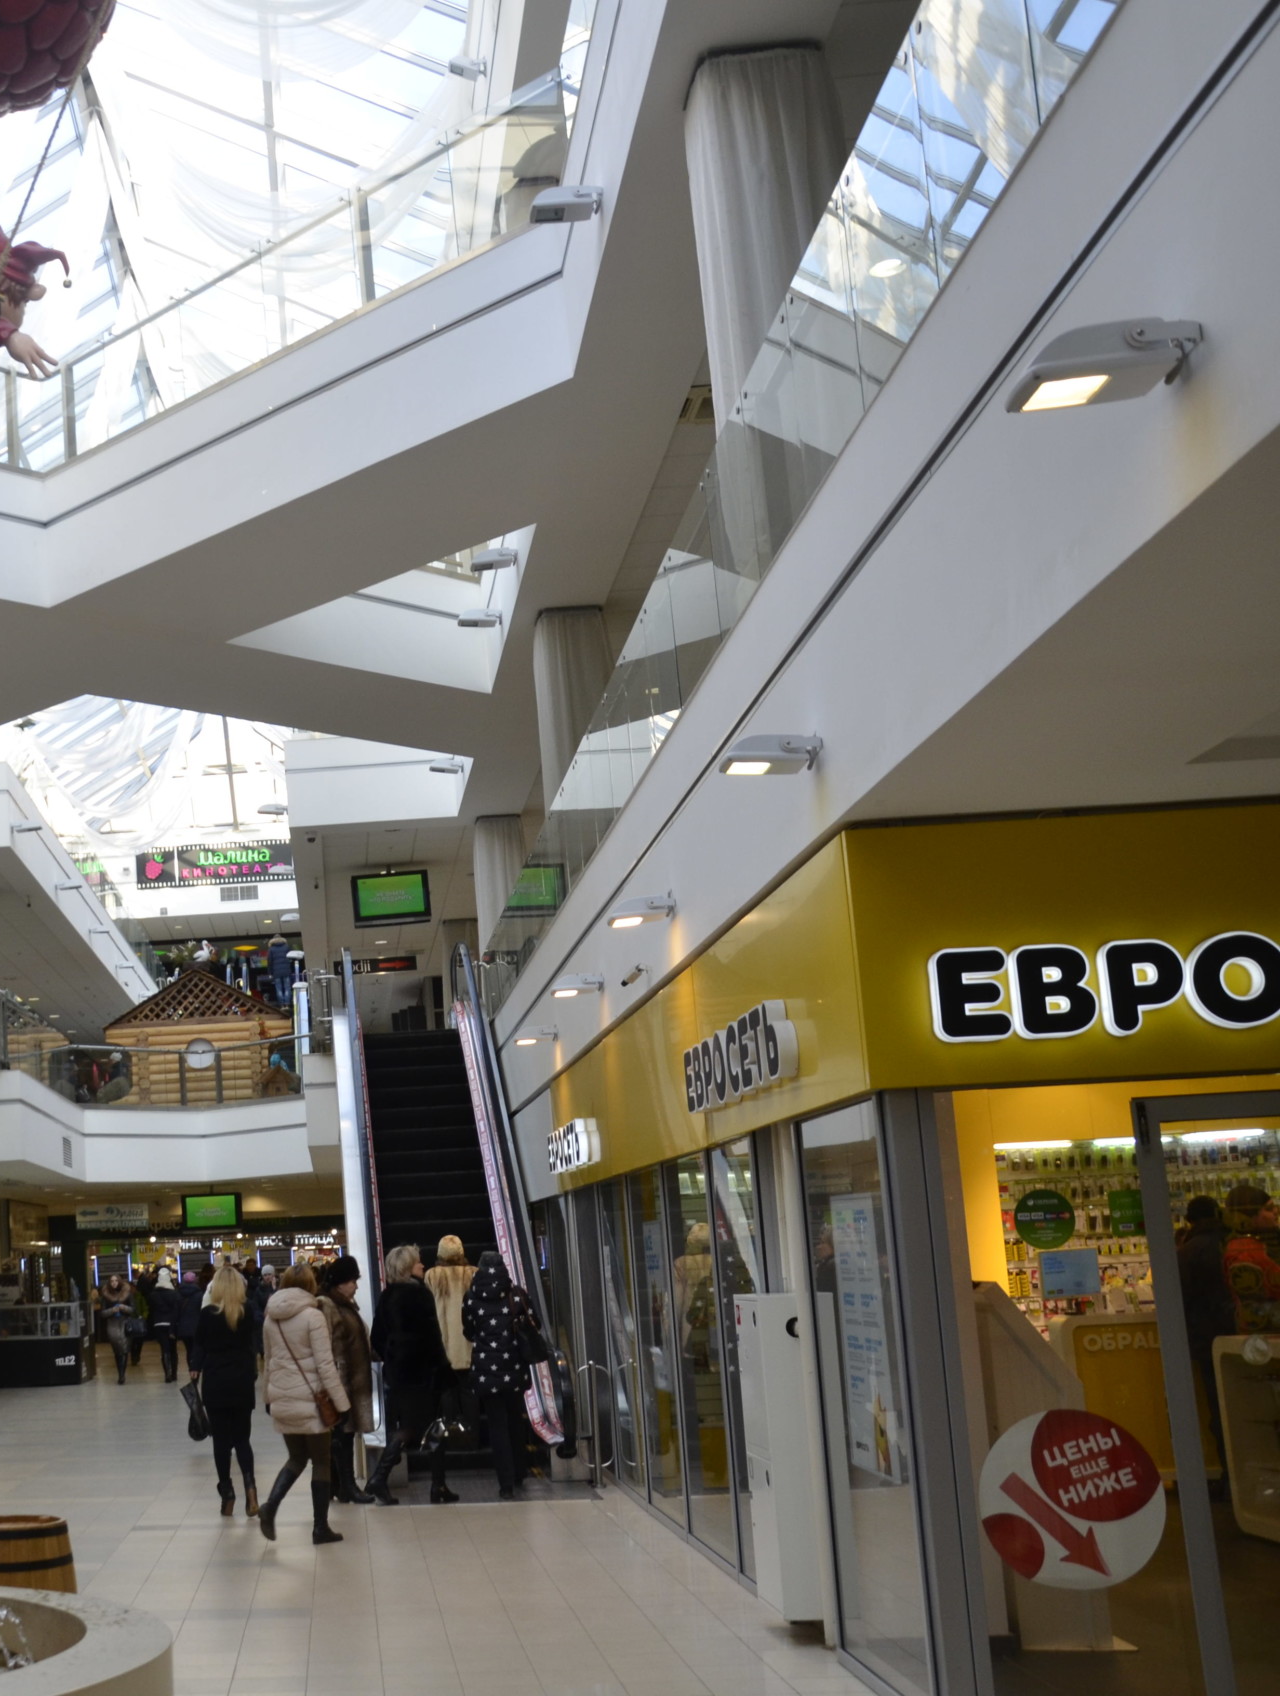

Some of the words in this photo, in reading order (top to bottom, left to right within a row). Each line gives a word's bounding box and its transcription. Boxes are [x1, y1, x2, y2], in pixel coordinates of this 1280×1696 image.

[683, 999, 788, 1114] ЕВРОСЕТЬ
[547, 1119, 583, 1175] ЕВРОСЕТЬ
[295, 1234, 335, 1245] ПТИЦА
[55, 1355, 76, 1366] TELE2
[1043, 1427, 1122, 1468] ЦЕНЫ
[1069, 1456, 1110, 1479] ЕЩЕ
[1058, 1467, 1138, 1507] НИЖЕ
